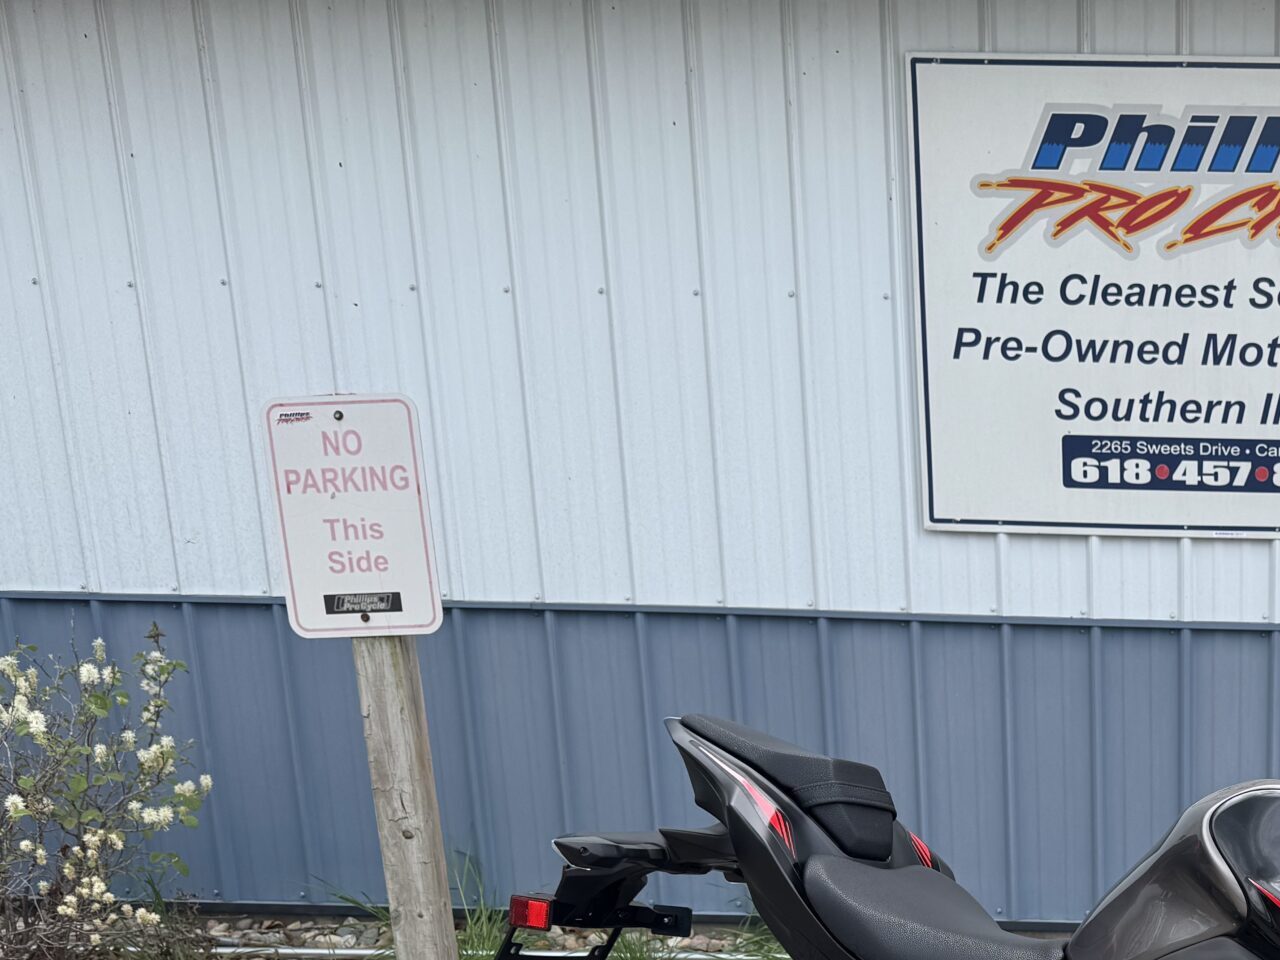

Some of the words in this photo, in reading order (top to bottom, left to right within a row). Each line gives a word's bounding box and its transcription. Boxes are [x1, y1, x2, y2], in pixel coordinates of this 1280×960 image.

[978, 176, 1194, 254] PRO
[972, 272, 1044, 305] The
[1060, 273, 1237, 309] Cleanest
[953, 327, 1190, 365] Pre-Owned
[1054, 387, 1246, 424] Southern
[320, 429, 363, 457] NO
[1091, 440, 1132, 454] 2265
[1136, 441, 1195, 456] Sweets
[1199, 442, 1241, 456] Drive
[283, 464, 410, 495] PARKING
[1070, 457, 1152, 484] 618
[1172, 460, 1252, 487] 457
[322, 517, 385, 542] This
[327, 550, 389, 575] Side
[344, 595, 378, 604] Phillips
